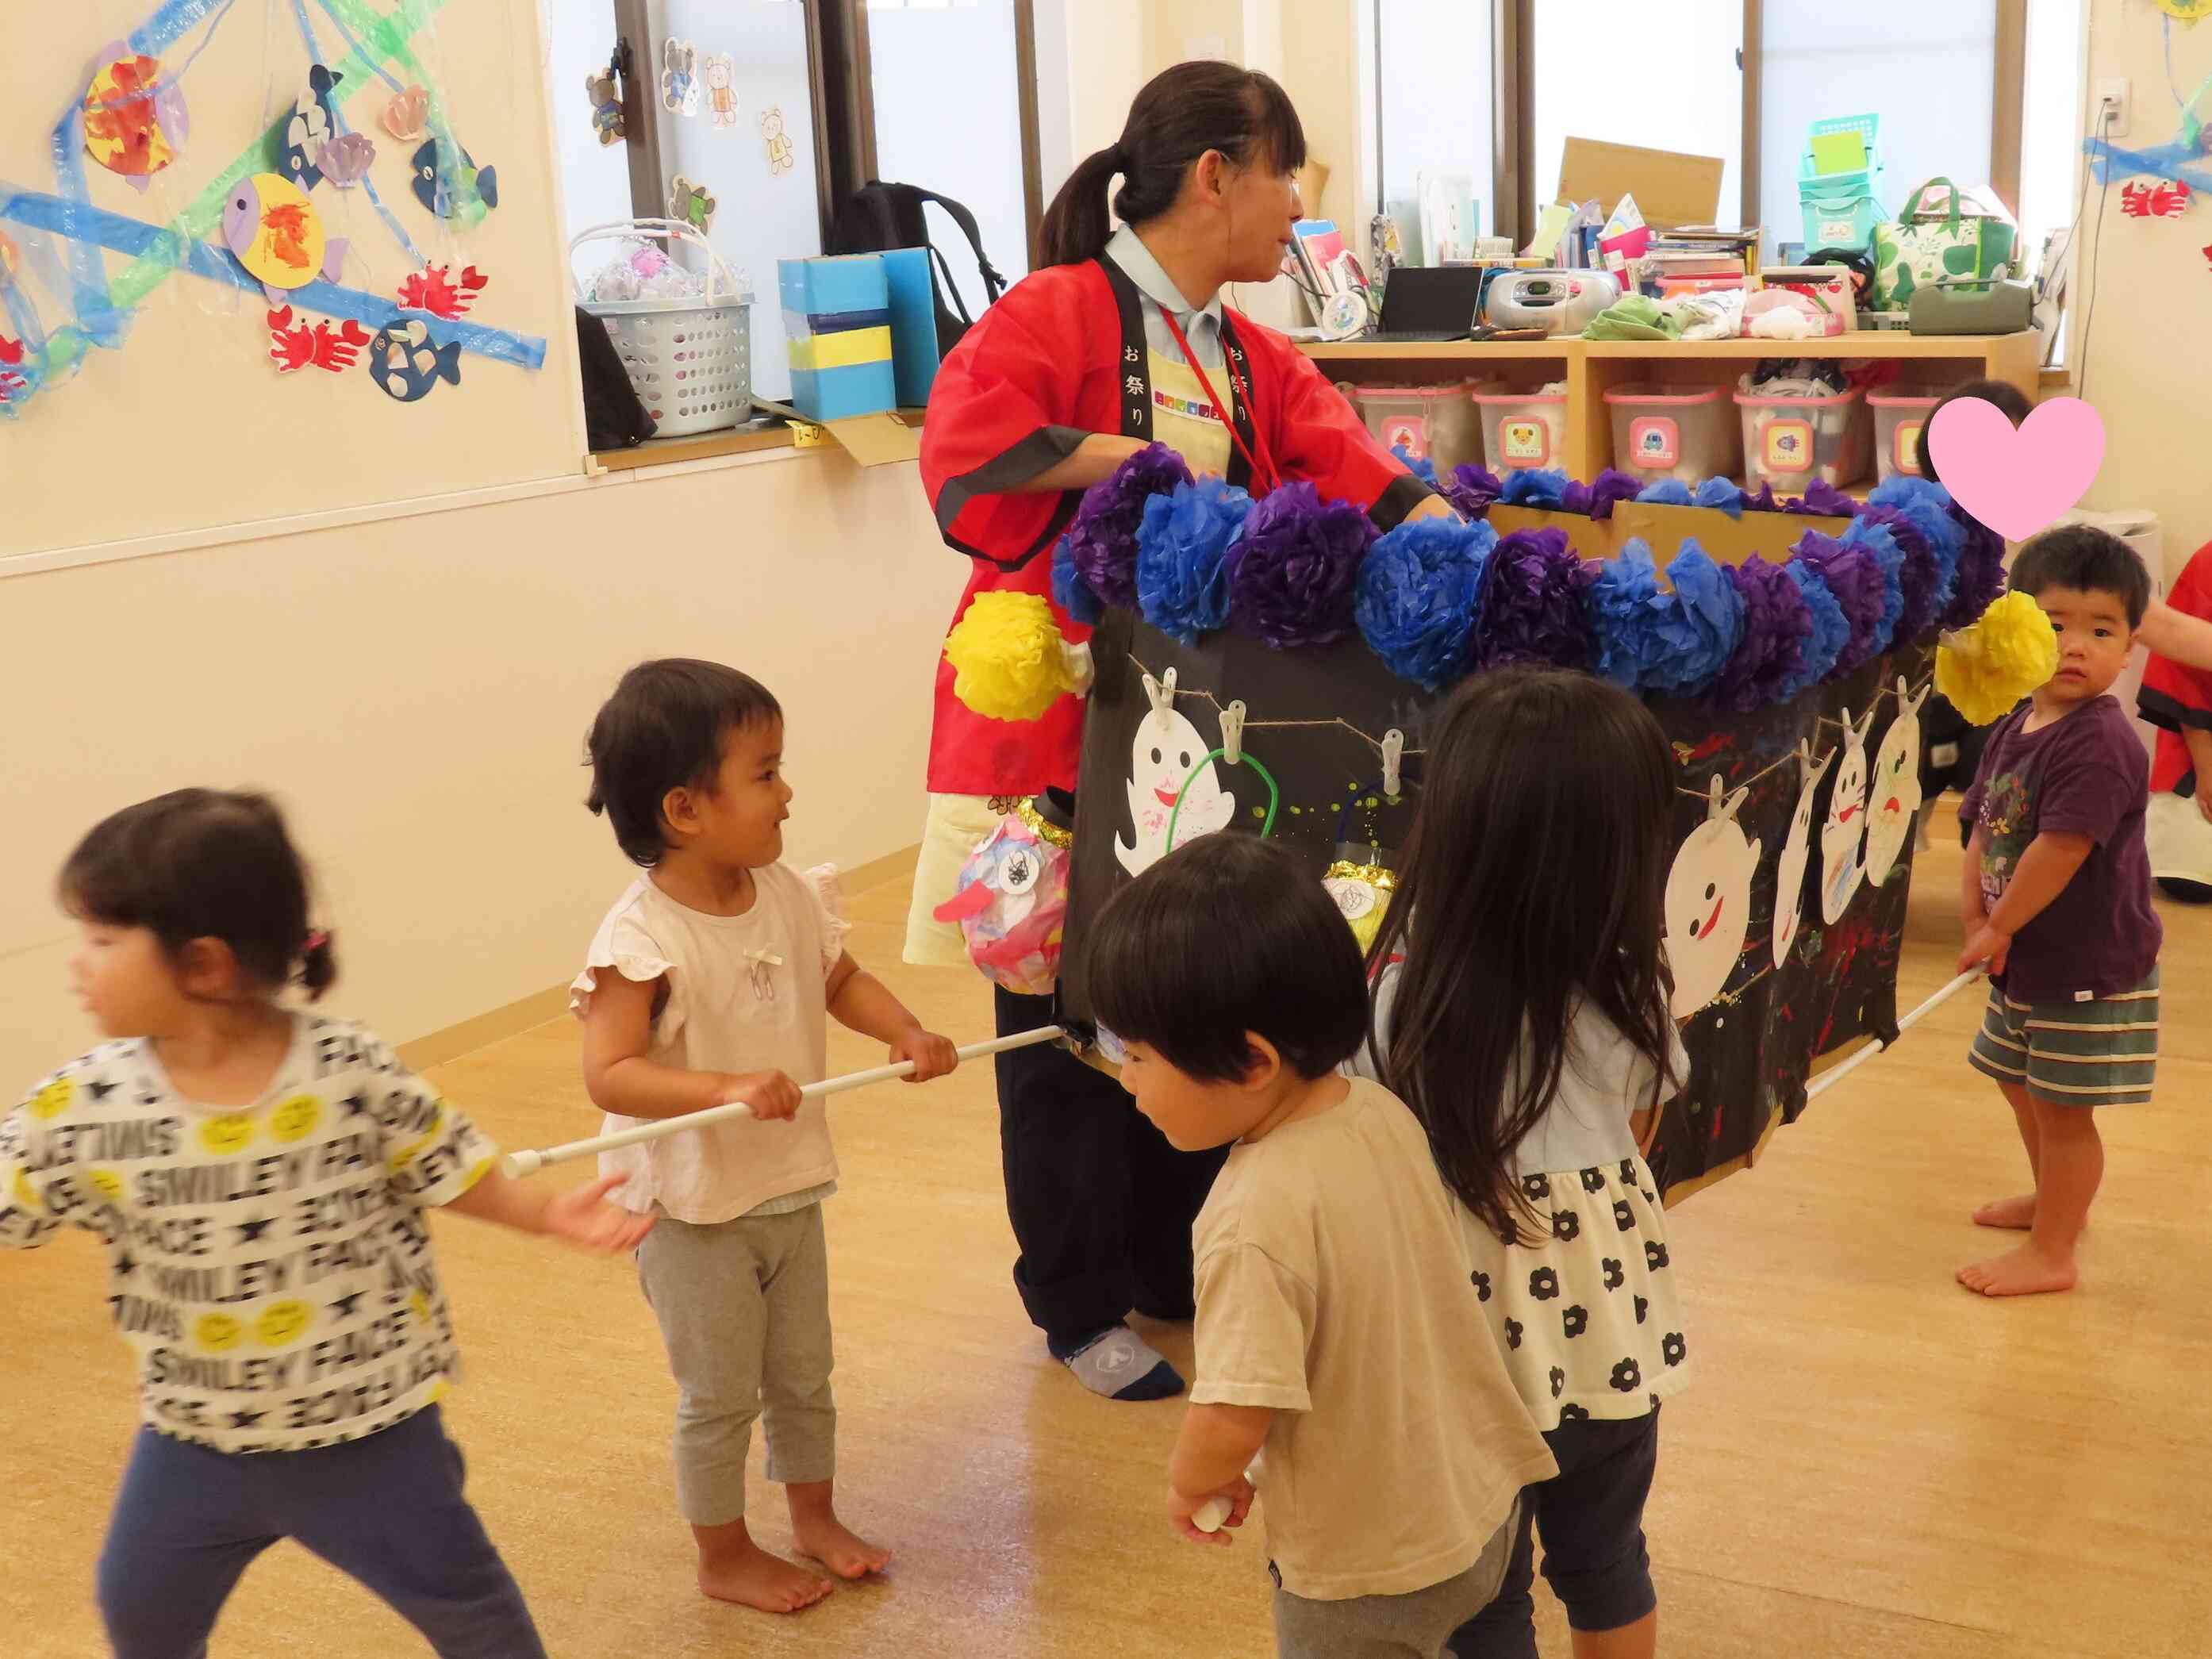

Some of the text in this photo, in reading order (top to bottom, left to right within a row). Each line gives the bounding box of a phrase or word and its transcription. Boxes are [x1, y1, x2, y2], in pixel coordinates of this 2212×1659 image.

[1123, 345, 1144, 426] お祭り
[140, 1148, 311, 1208] SMILEY
[148, 1347, 301, 1391] SMILEY
